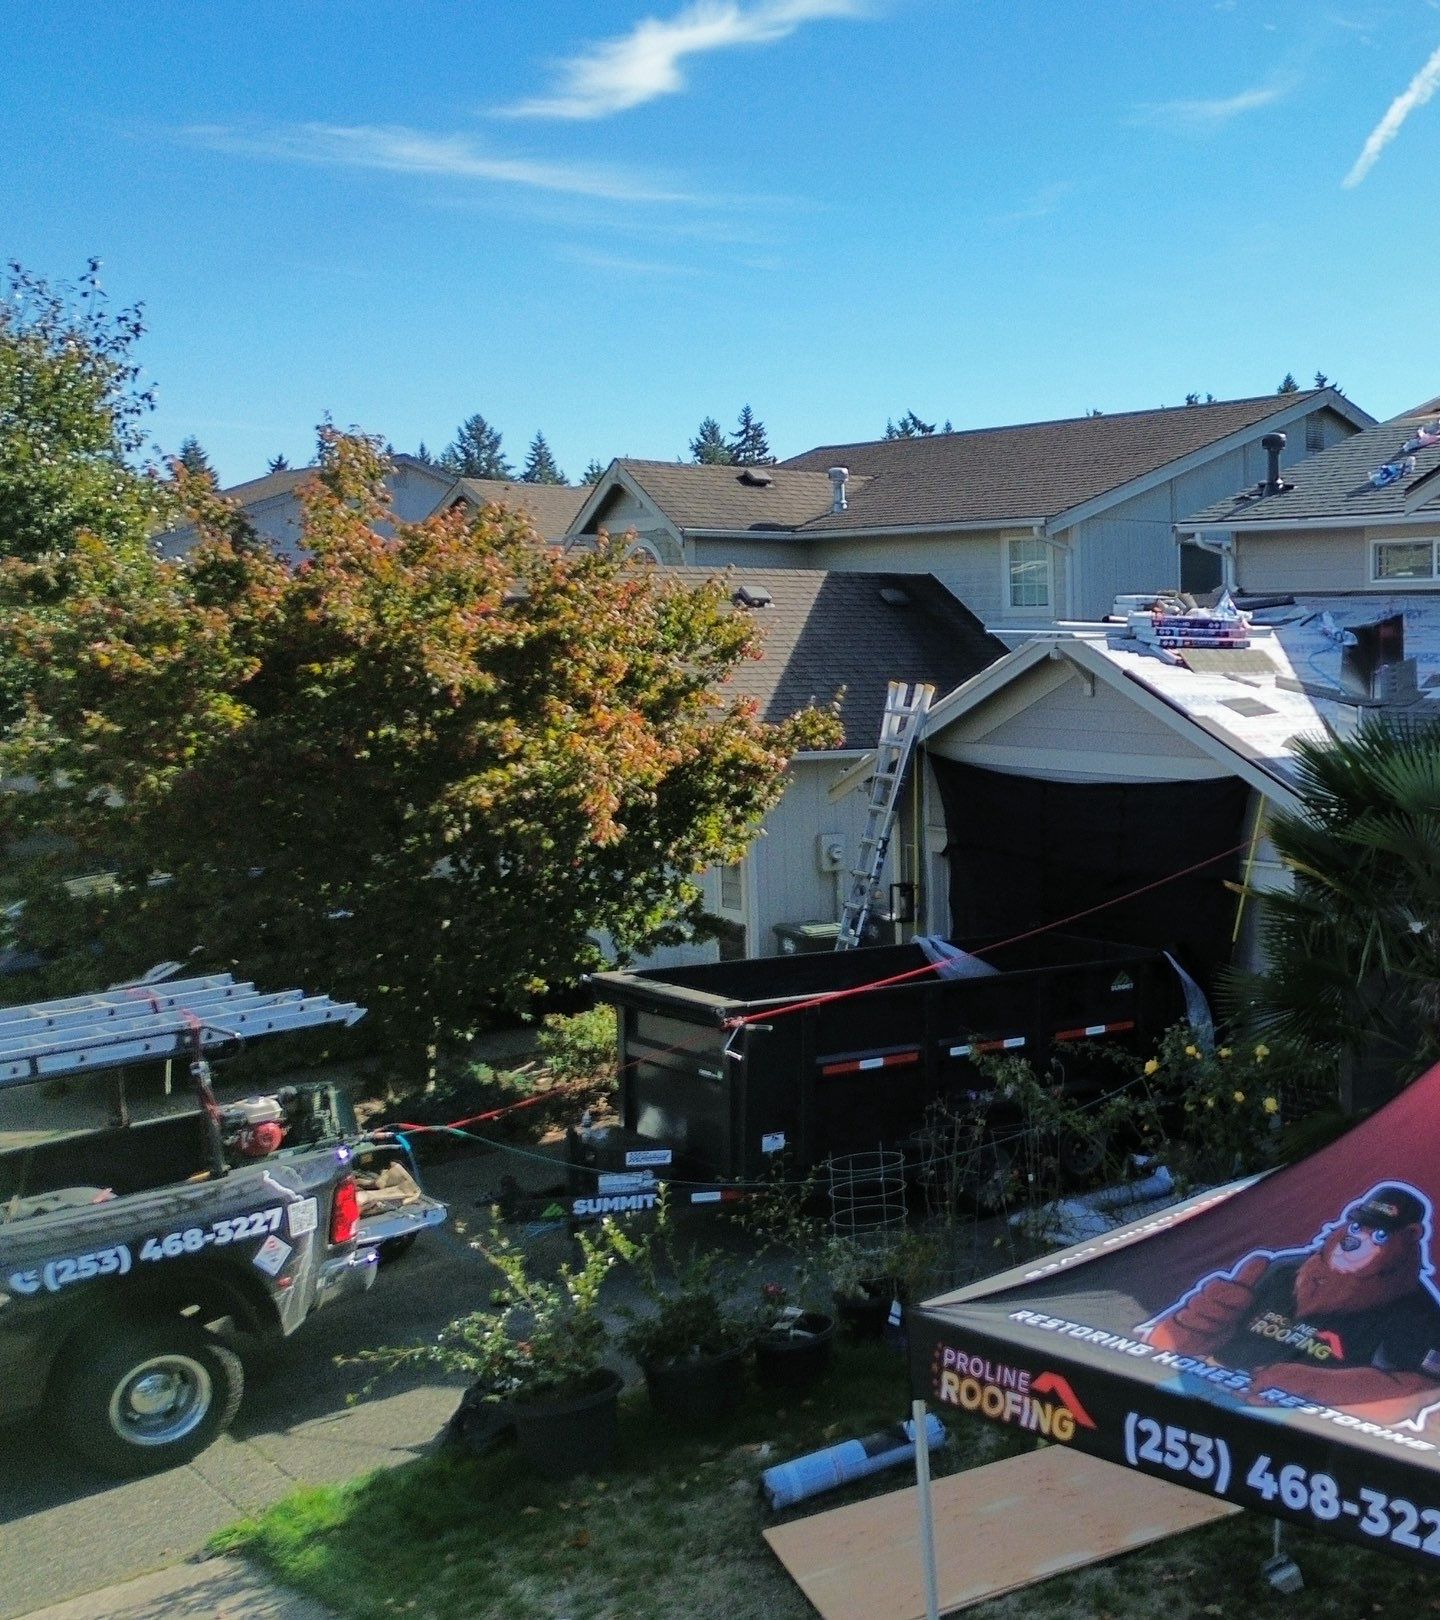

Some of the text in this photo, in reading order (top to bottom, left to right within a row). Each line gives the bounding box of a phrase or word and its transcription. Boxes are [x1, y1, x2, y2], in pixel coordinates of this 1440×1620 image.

[572, 1192, 658, 1215] SUMMIT
[44, 1244, 132, 1291] (253)
[139, 1206, 283, 1262] 468-3227
[942, 1347, 1032, 1394] PROLINE
[1250, 1320, 1332, 1360] ROOFING
[939, 1369, 1077, 1442] ROOFING
[1008, 1309, 1155, 1358] RESTORING
[1258, 1387, 1437, 1451] RESTORING
[1123, 1411, 1232, 1495] (253)
